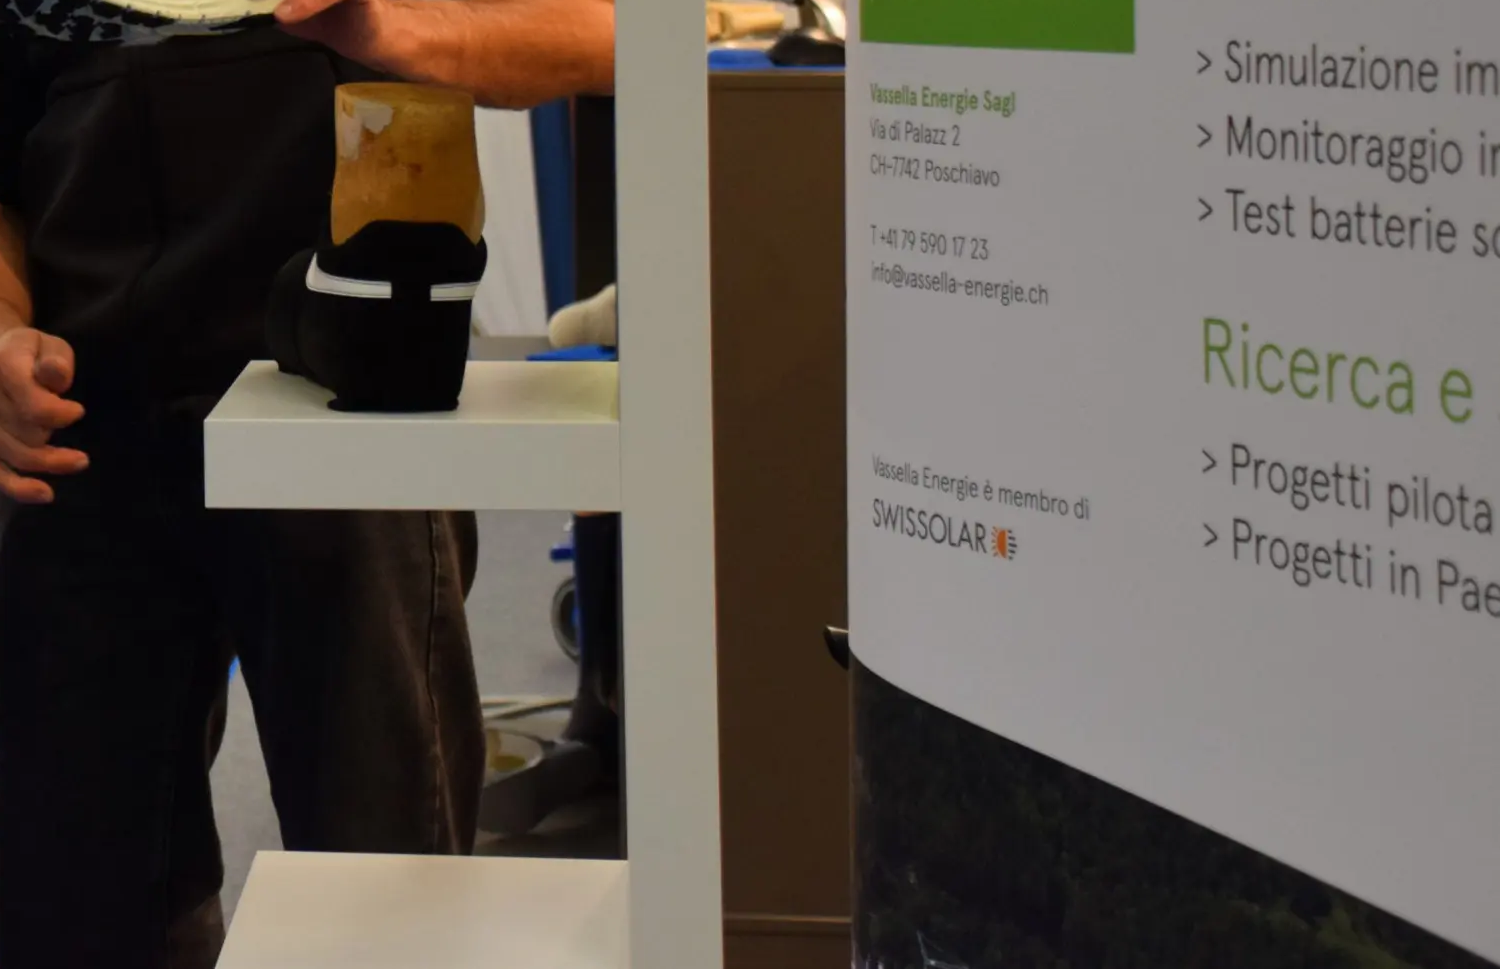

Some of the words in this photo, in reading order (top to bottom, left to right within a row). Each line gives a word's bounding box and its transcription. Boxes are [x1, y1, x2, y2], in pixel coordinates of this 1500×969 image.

[1225, 39, 1439, 93] Simulazione
[870, 82, 917, 107] Vassella
[922, 87, 978, 115] Energie
[870, 117, 886, 140] Via
[889, 120, 900, 142] di
[905, 121, 946, 146] Palazz
[952, 125, 961, 147] 2
[1226, 114, 1463, 185] Monitoraggio
[870, 154, 920, 180] CH-7742
[925, 160, 1000, 188] Poschiavo
[902, 230, 916, 251] 79
[920, 232, 947, 256] 590
[953, 235, 965, 258] 17
[971, 238, 989, 261] 23
[1225, 188, 1296, 238] Test
[1311, 195, 1457, 254] batterie
[871, 260, 1049, 307] info@vassella-energie.ch
[1203, 317, 1414, 415] Ricerca
[1440, 368, 1473, 424] e
[872, 453, 919, 487] Vassella
[923, 466, 979, 502] Energie
[983, 479, 993, 501] è
[999, 486, 1069, 516] membro
[1074, 497, 1090, 520] di
[1231, 443, 1370, 511] Progetti
[1388, 475, 1493, 535] pilota
[872, 498, 988, 554] SWISSOLAR
[1233, 517, 1372, 587] Progetti
[1389, 549, 1420, 600] in
